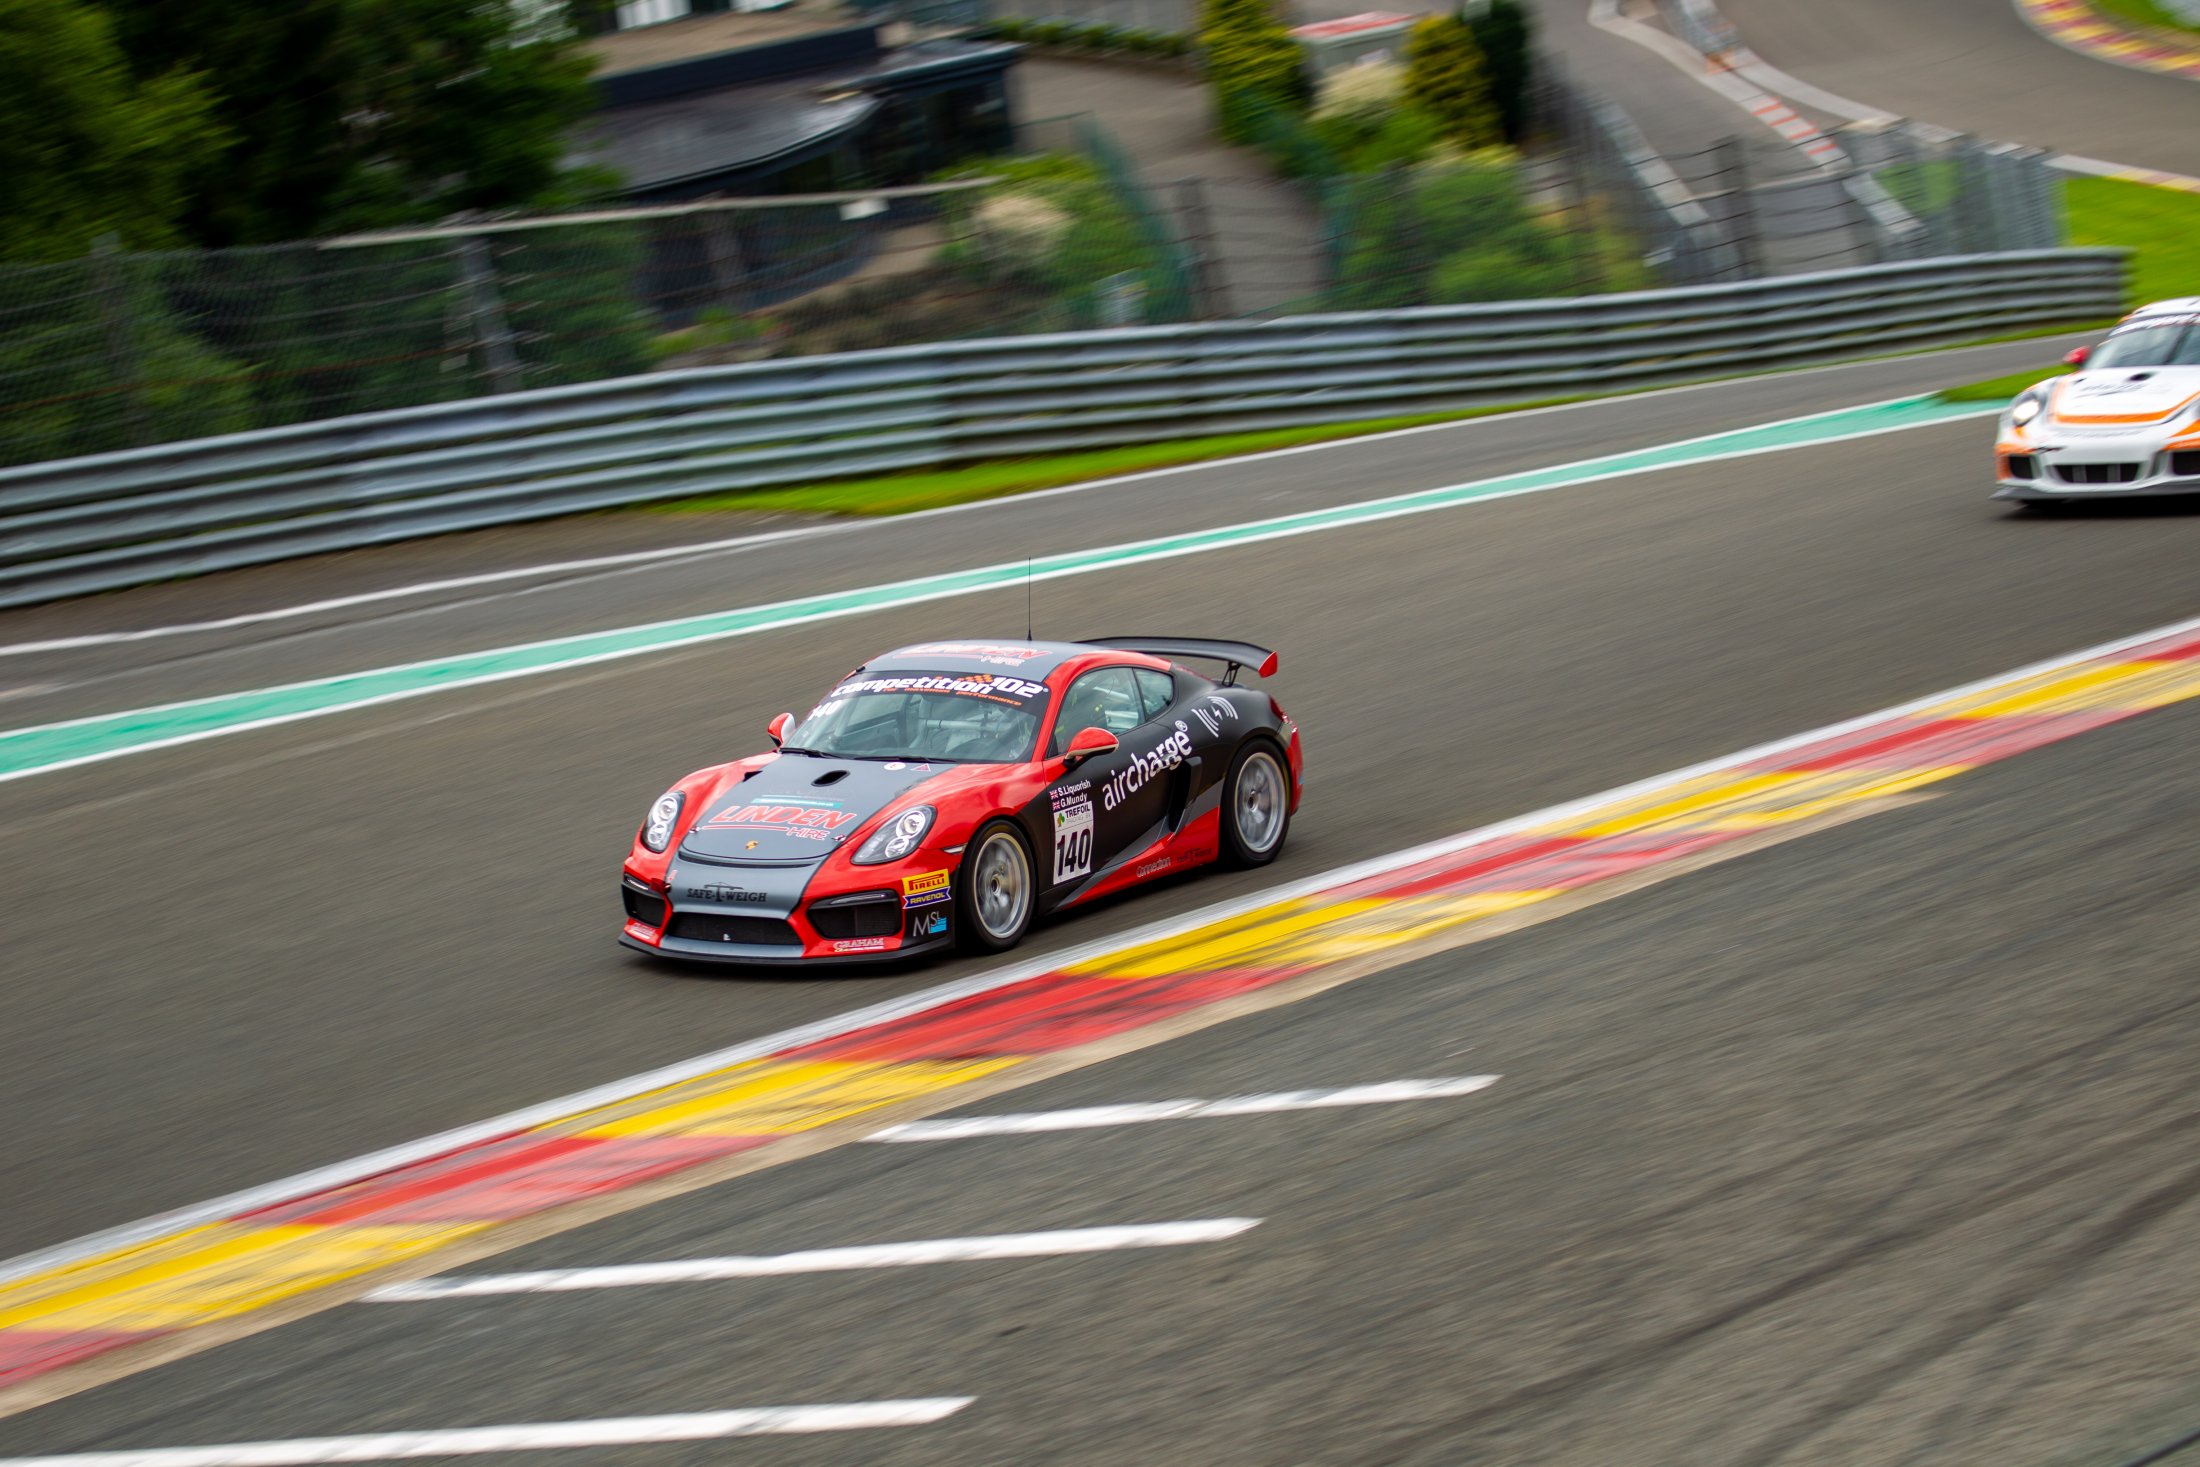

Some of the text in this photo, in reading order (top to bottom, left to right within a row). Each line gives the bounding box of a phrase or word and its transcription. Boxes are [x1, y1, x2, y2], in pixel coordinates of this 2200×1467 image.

[830, 676, 1044, 698] competition 102
[956, 690, 1022, 706] performance
[1057, 779, 1091, 797] S.Liquorish
[1060, 792, 1088, 808] G.Mundy
[708, 805, 857, 829] LINDEN
[1065, 804, 1090, 818] TREFOIL
[786, 827, 830, 841] HIRE
[1057, 828, 1091, 877] 140
[908, 873, 945, 891] PIRELLI
[910, 892, 945, 904] RAVENOL
[833, 938, 884, 951] GRAHAM
